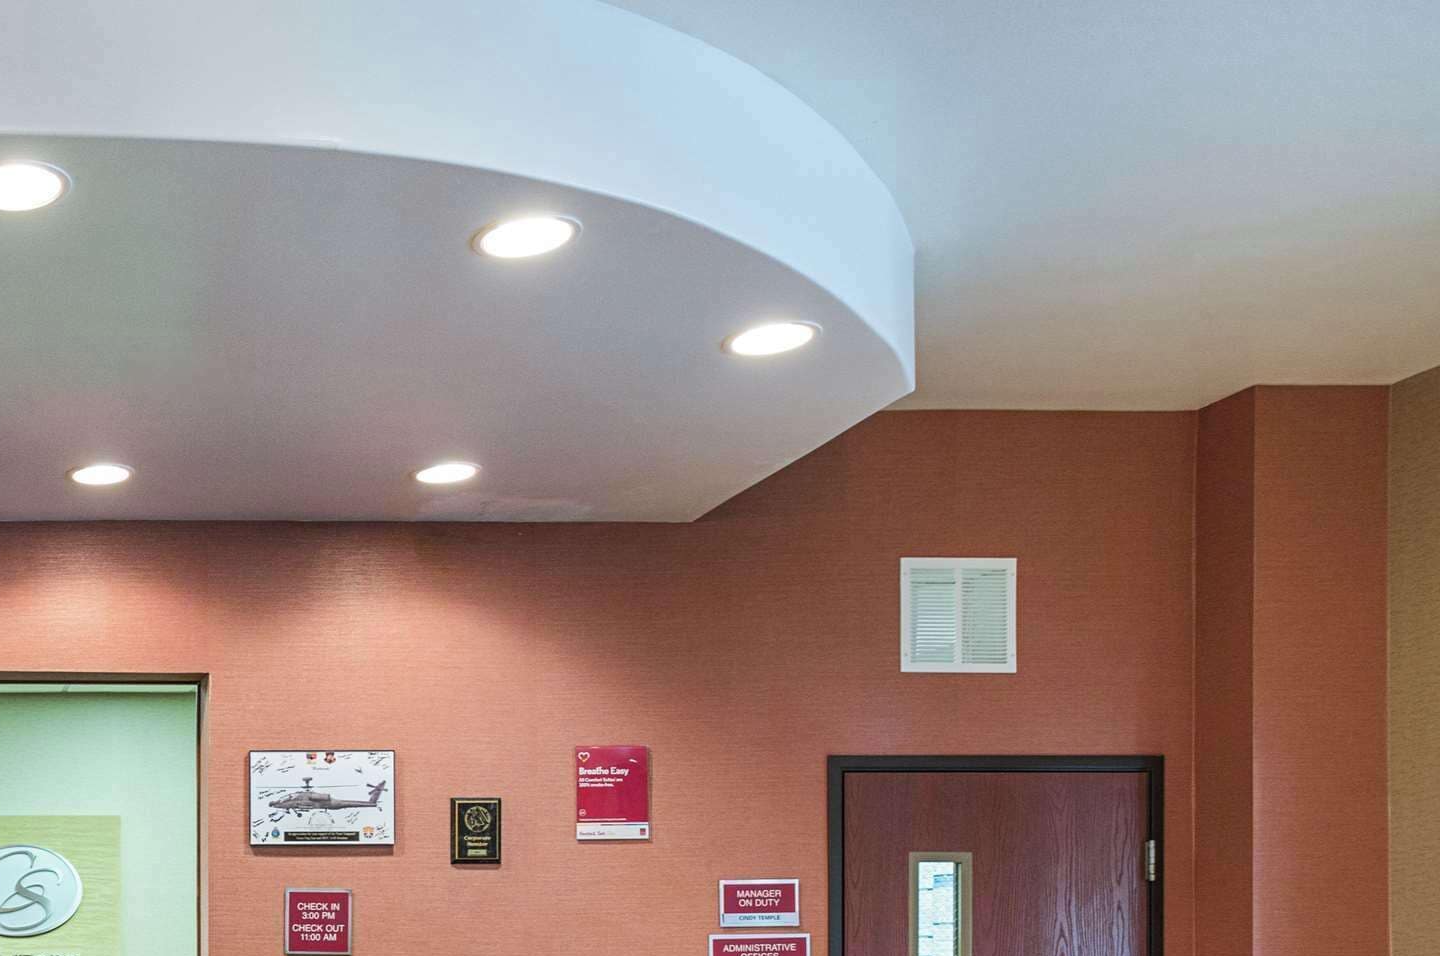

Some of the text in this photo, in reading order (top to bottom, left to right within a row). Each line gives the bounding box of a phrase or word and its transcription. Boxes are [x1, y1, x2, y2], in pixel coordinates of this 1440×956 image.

[578, 766, 630, 776] Breathe Easy
[736, 889, 782, 898] MANAGER
[296, 902, 340, 911] CHECK IN
[738, 898, 780, 907] ON DUTY
[301, 911, 336, 920] 3:00 PM
[292, 924, 345, 933] CHECK OUT
[300, 933, 337, 941] 11:00 AM
[722, 943, 797, 953] ADMINISTRATIVE
